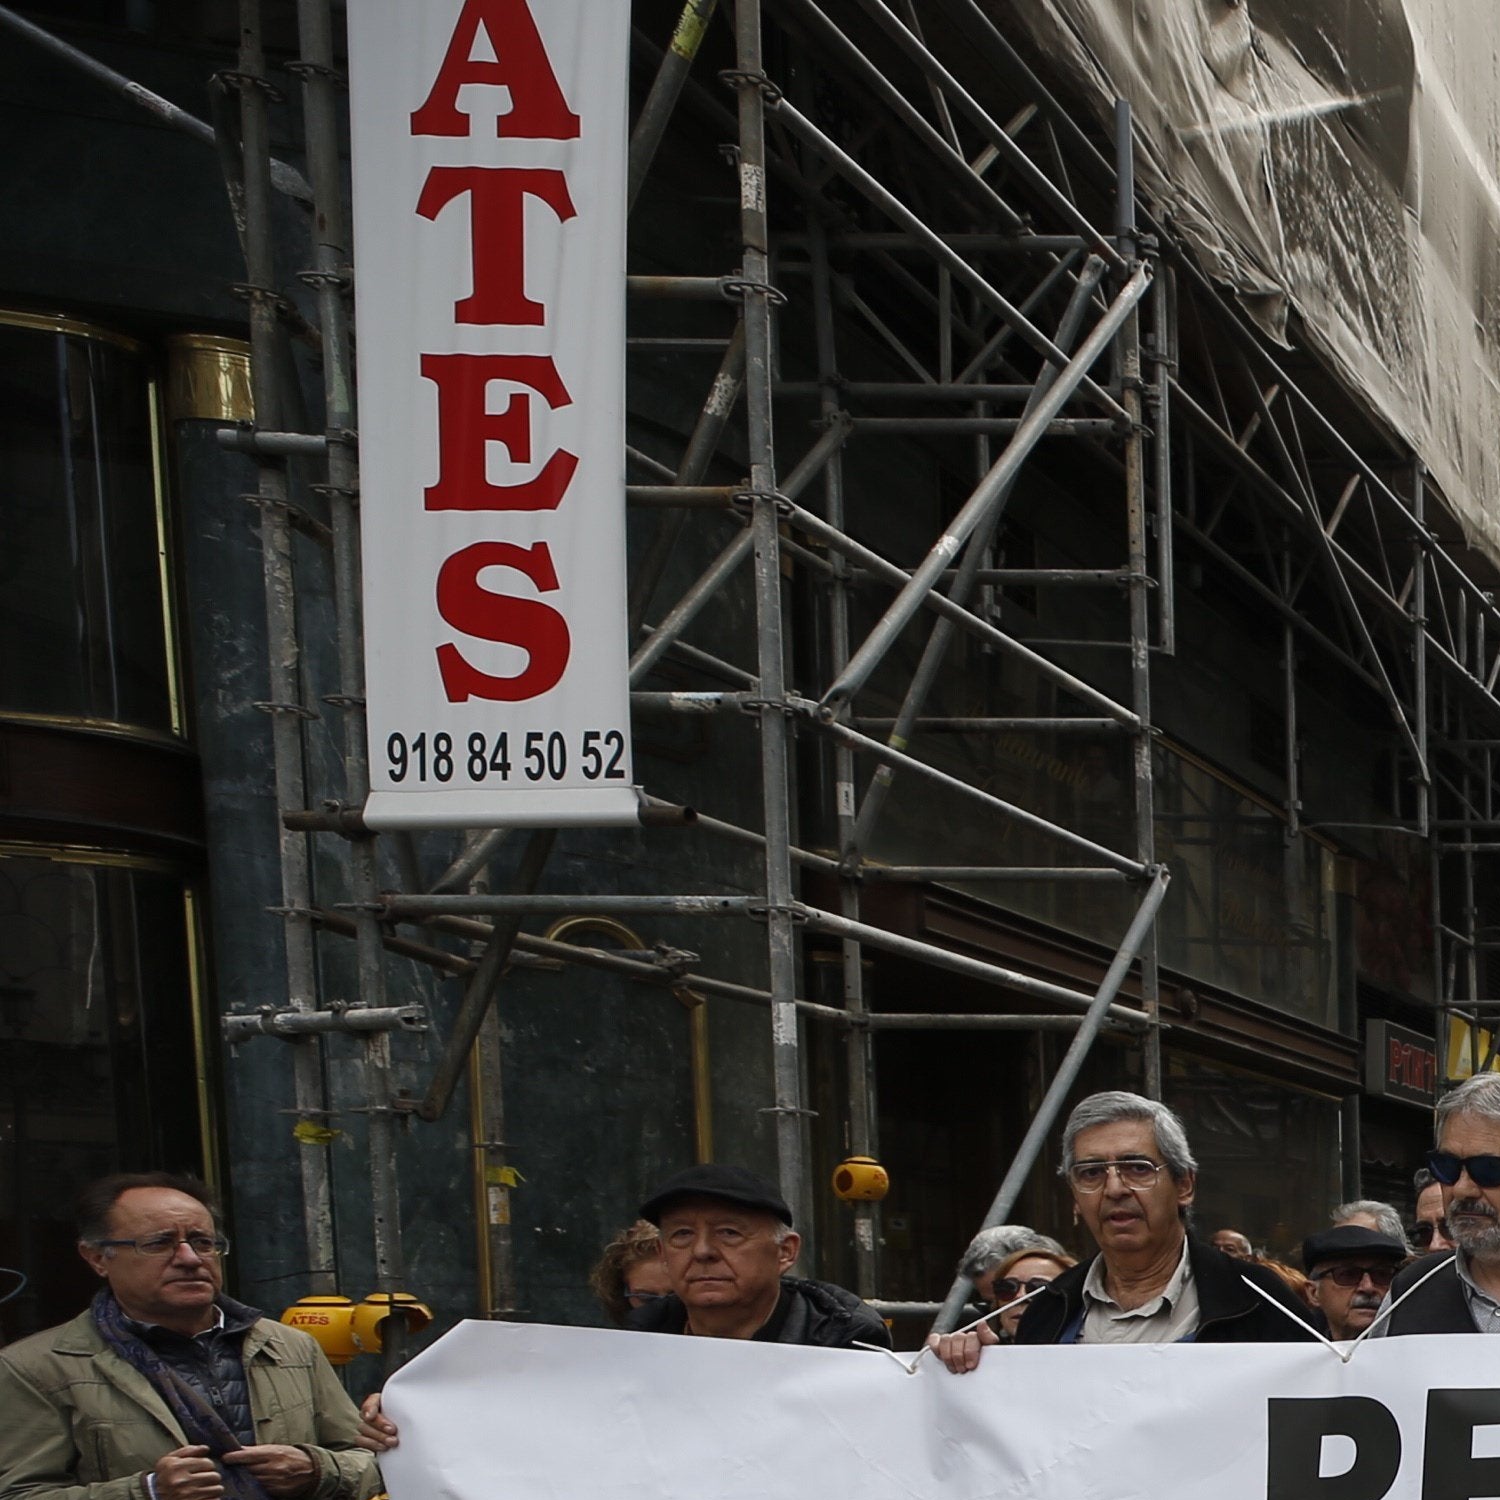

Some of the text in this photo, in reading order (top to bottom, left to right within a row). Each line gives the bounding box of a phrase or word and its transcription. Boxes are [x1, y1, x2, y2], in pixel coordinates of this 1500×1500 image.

[413, 0, 581, 703] ATES
[388, 730, 625, 783] 918 84 50 52
[289, 1315, 329, 1326] ATES
